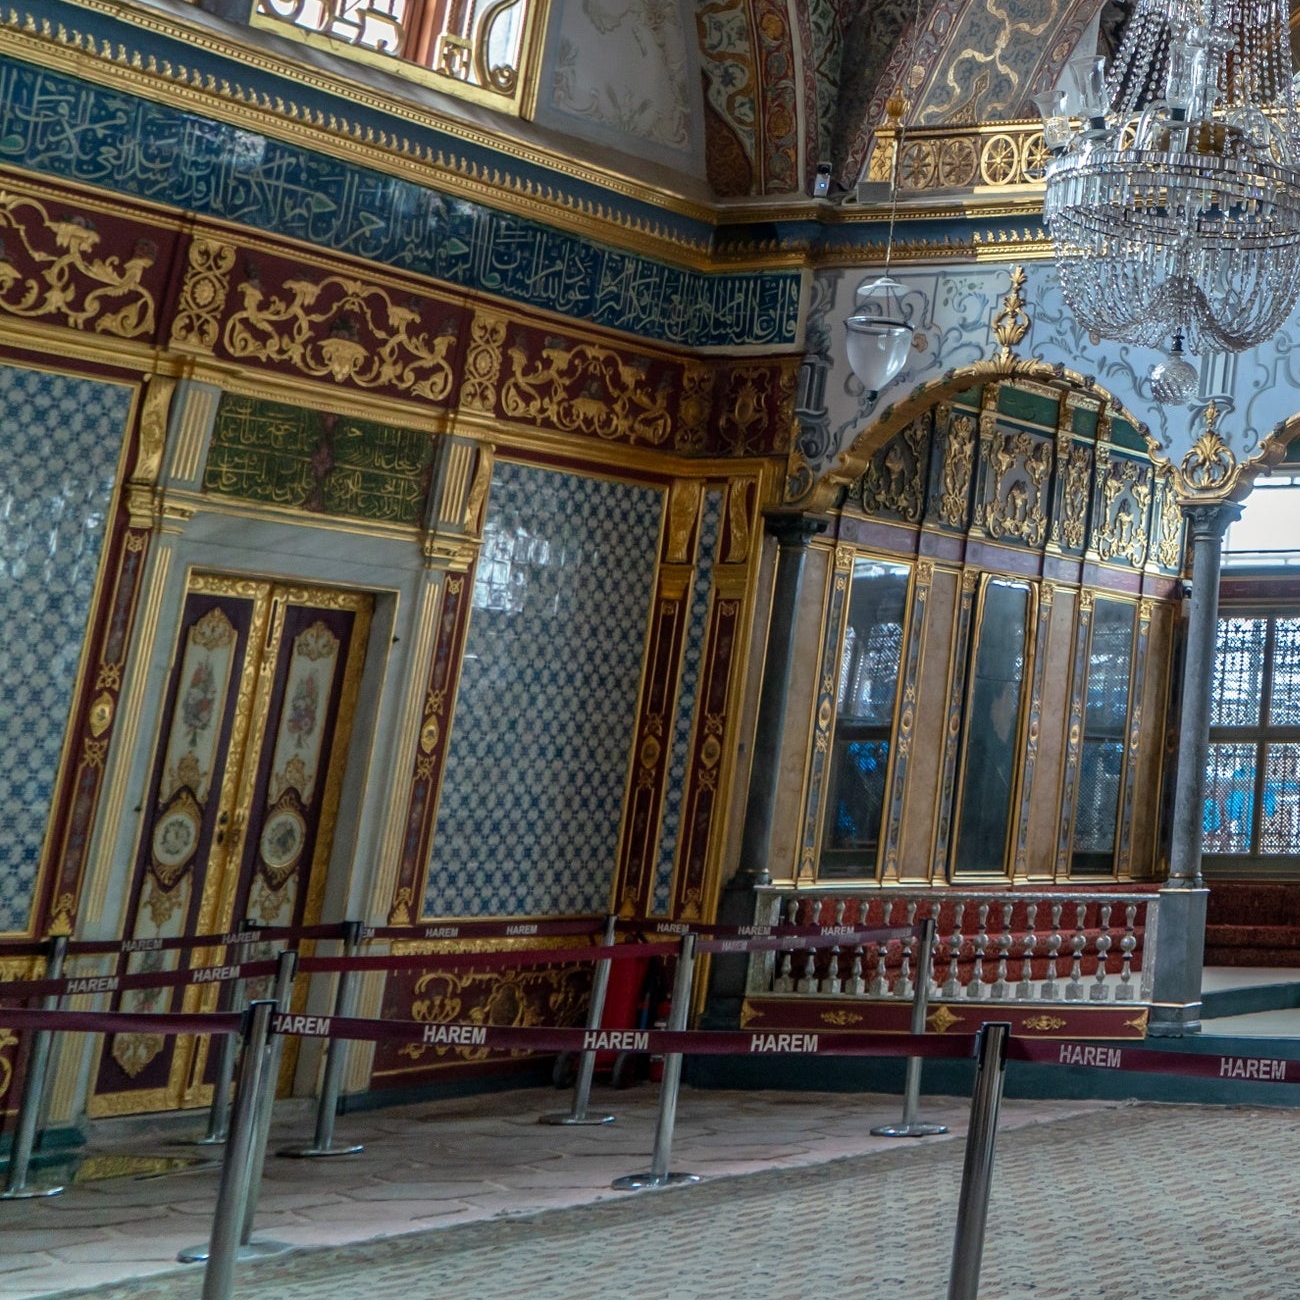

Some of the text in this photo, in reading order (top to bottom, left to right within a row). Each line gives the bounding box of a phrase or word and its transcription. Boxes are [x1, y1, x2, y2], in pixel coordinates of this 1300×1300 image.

[121, 931, 261, 952] HAREM HAREM
[425, 925, 538, 938] HAREM HAREM
[656, 923, 855, 936] HAREM HAREM HAREM
[68, 966, 240, 994] HAREM HAREM
[423, 1025, 487, 1045] HAREM
[583, 1031, 649, 1051] HAREM
[750, 1034, 819, 1053] HAREM
[1059, 1044, 1122, 1068] HAREM
[1219, 1057, 1287, 1080] HAREM
